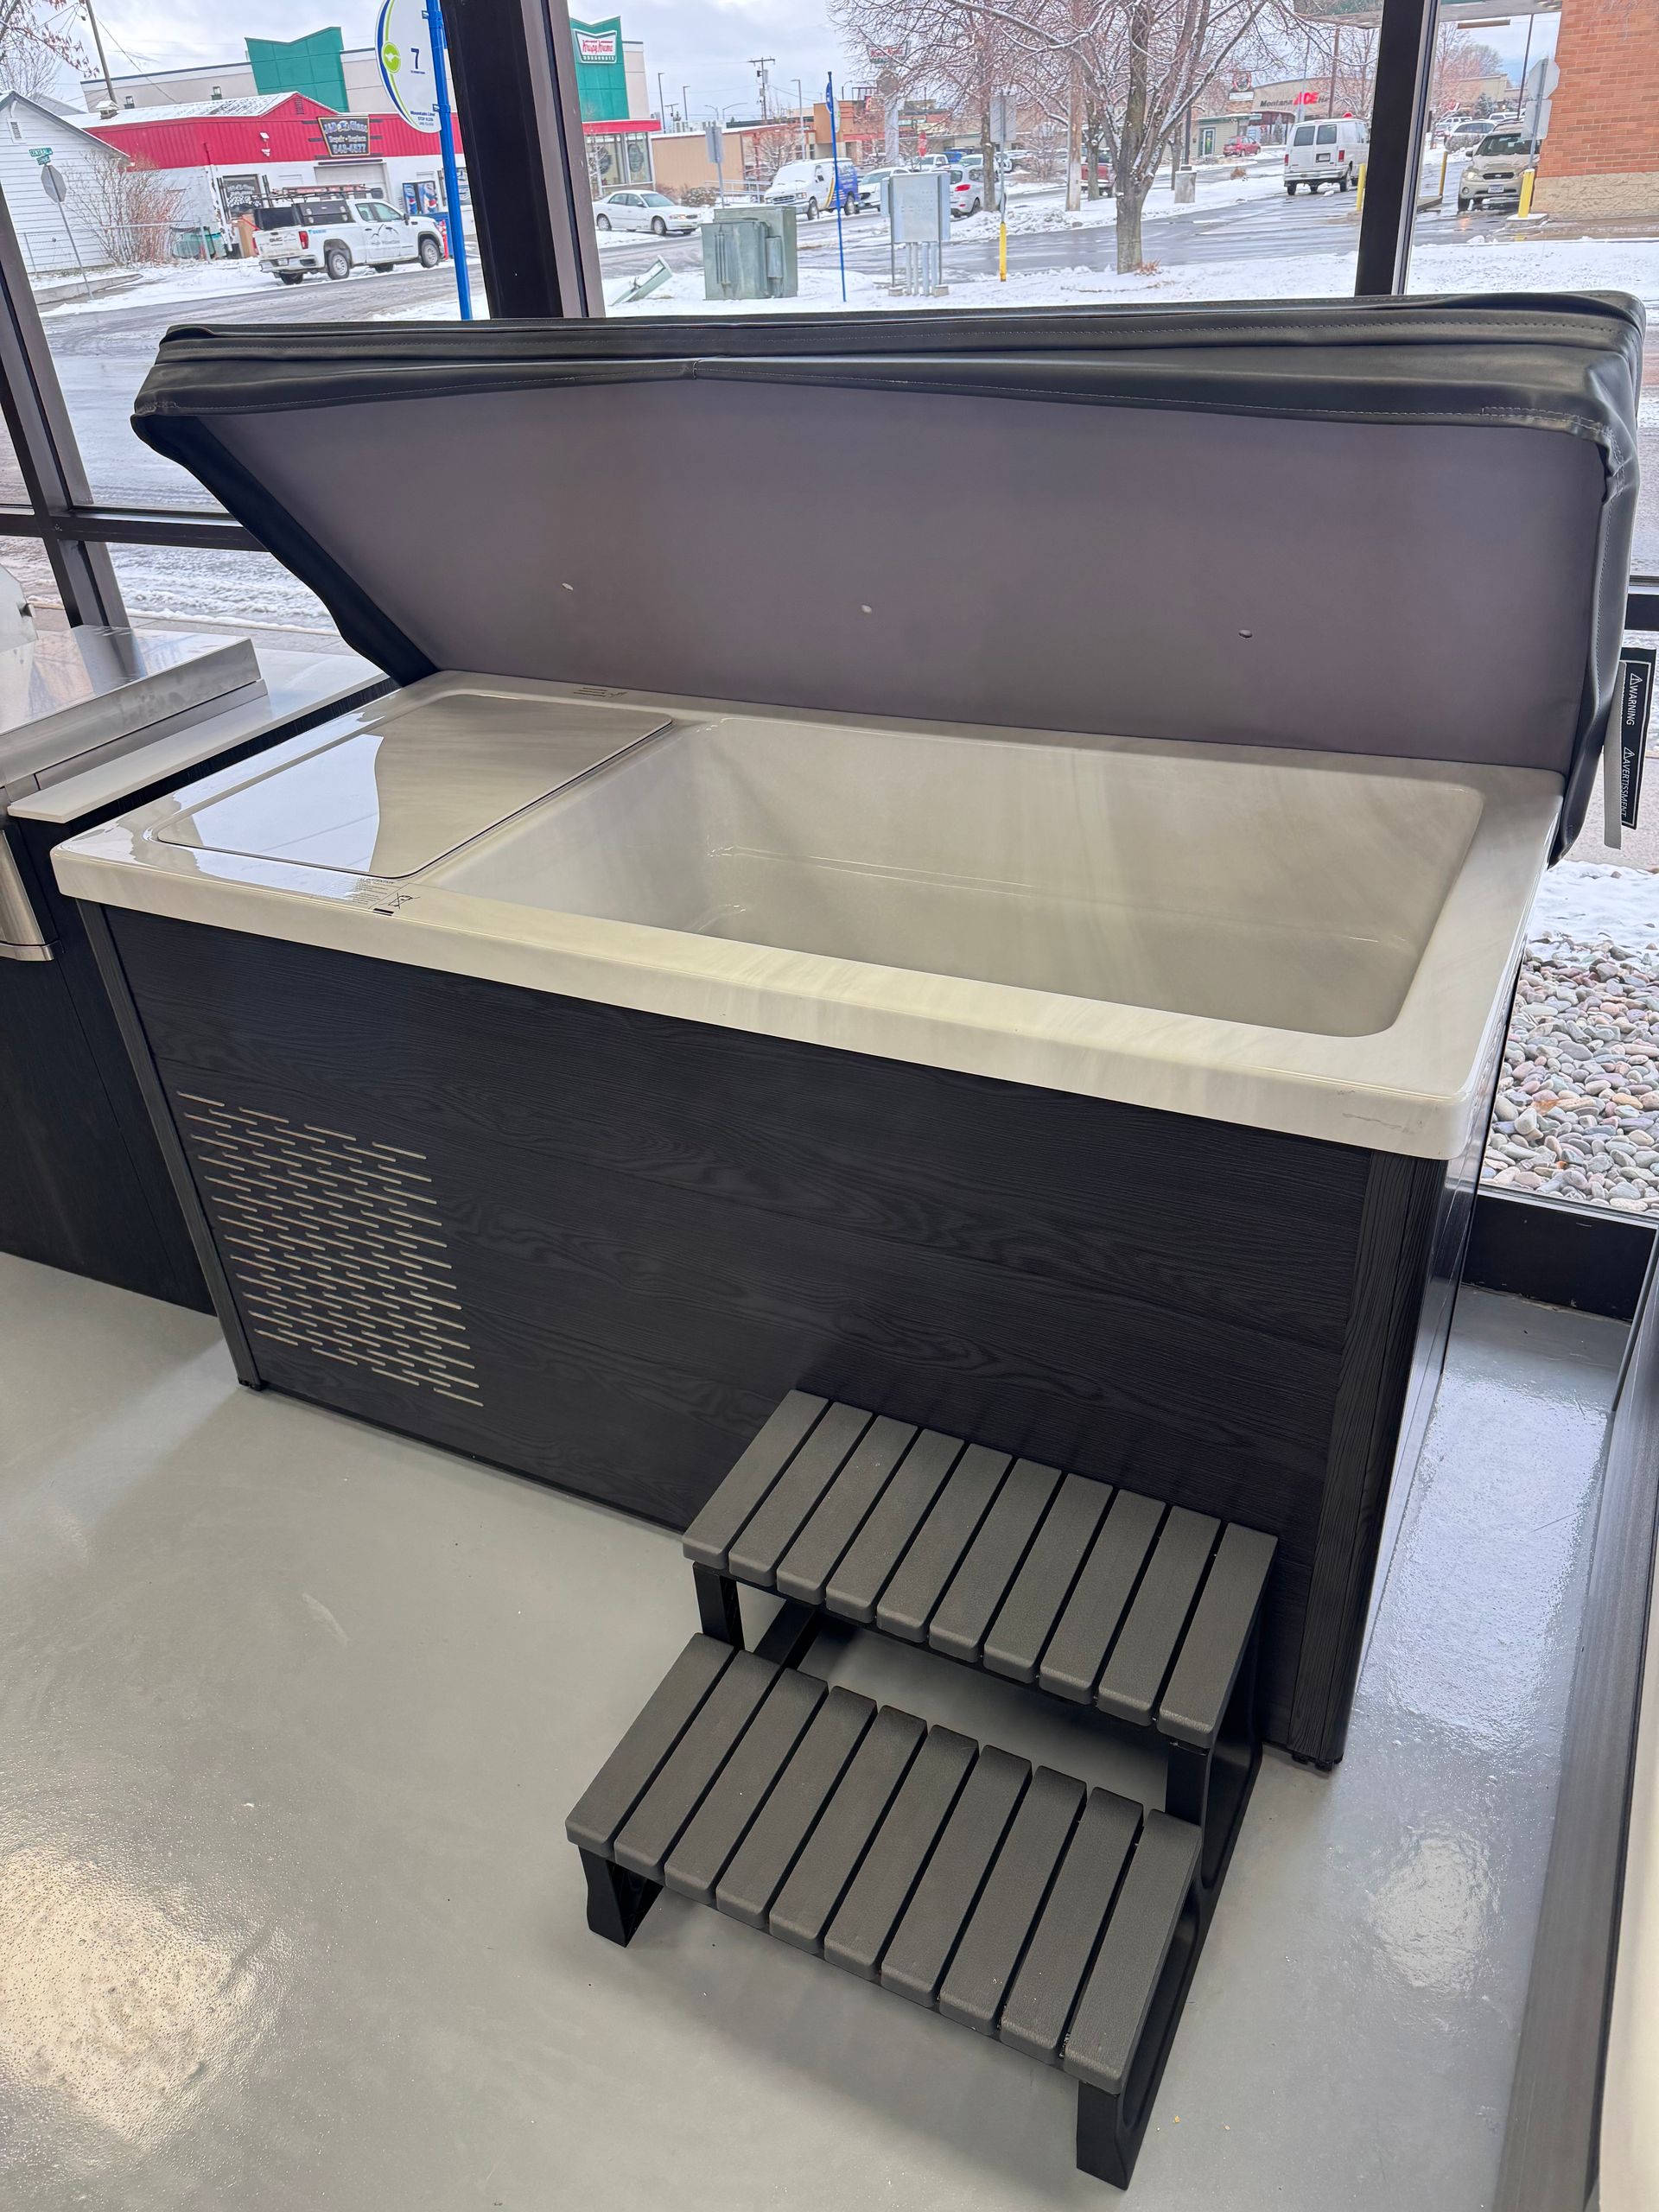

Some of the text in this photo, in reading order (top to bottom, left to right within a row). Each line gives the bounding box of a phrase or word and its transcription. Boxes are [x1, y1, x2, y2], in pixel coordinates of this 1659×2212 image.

[410, 48, 420, 69] 7
[1293, 92, 1319, 105] ACE
[1626, 685, 1638, 726] WARNING
